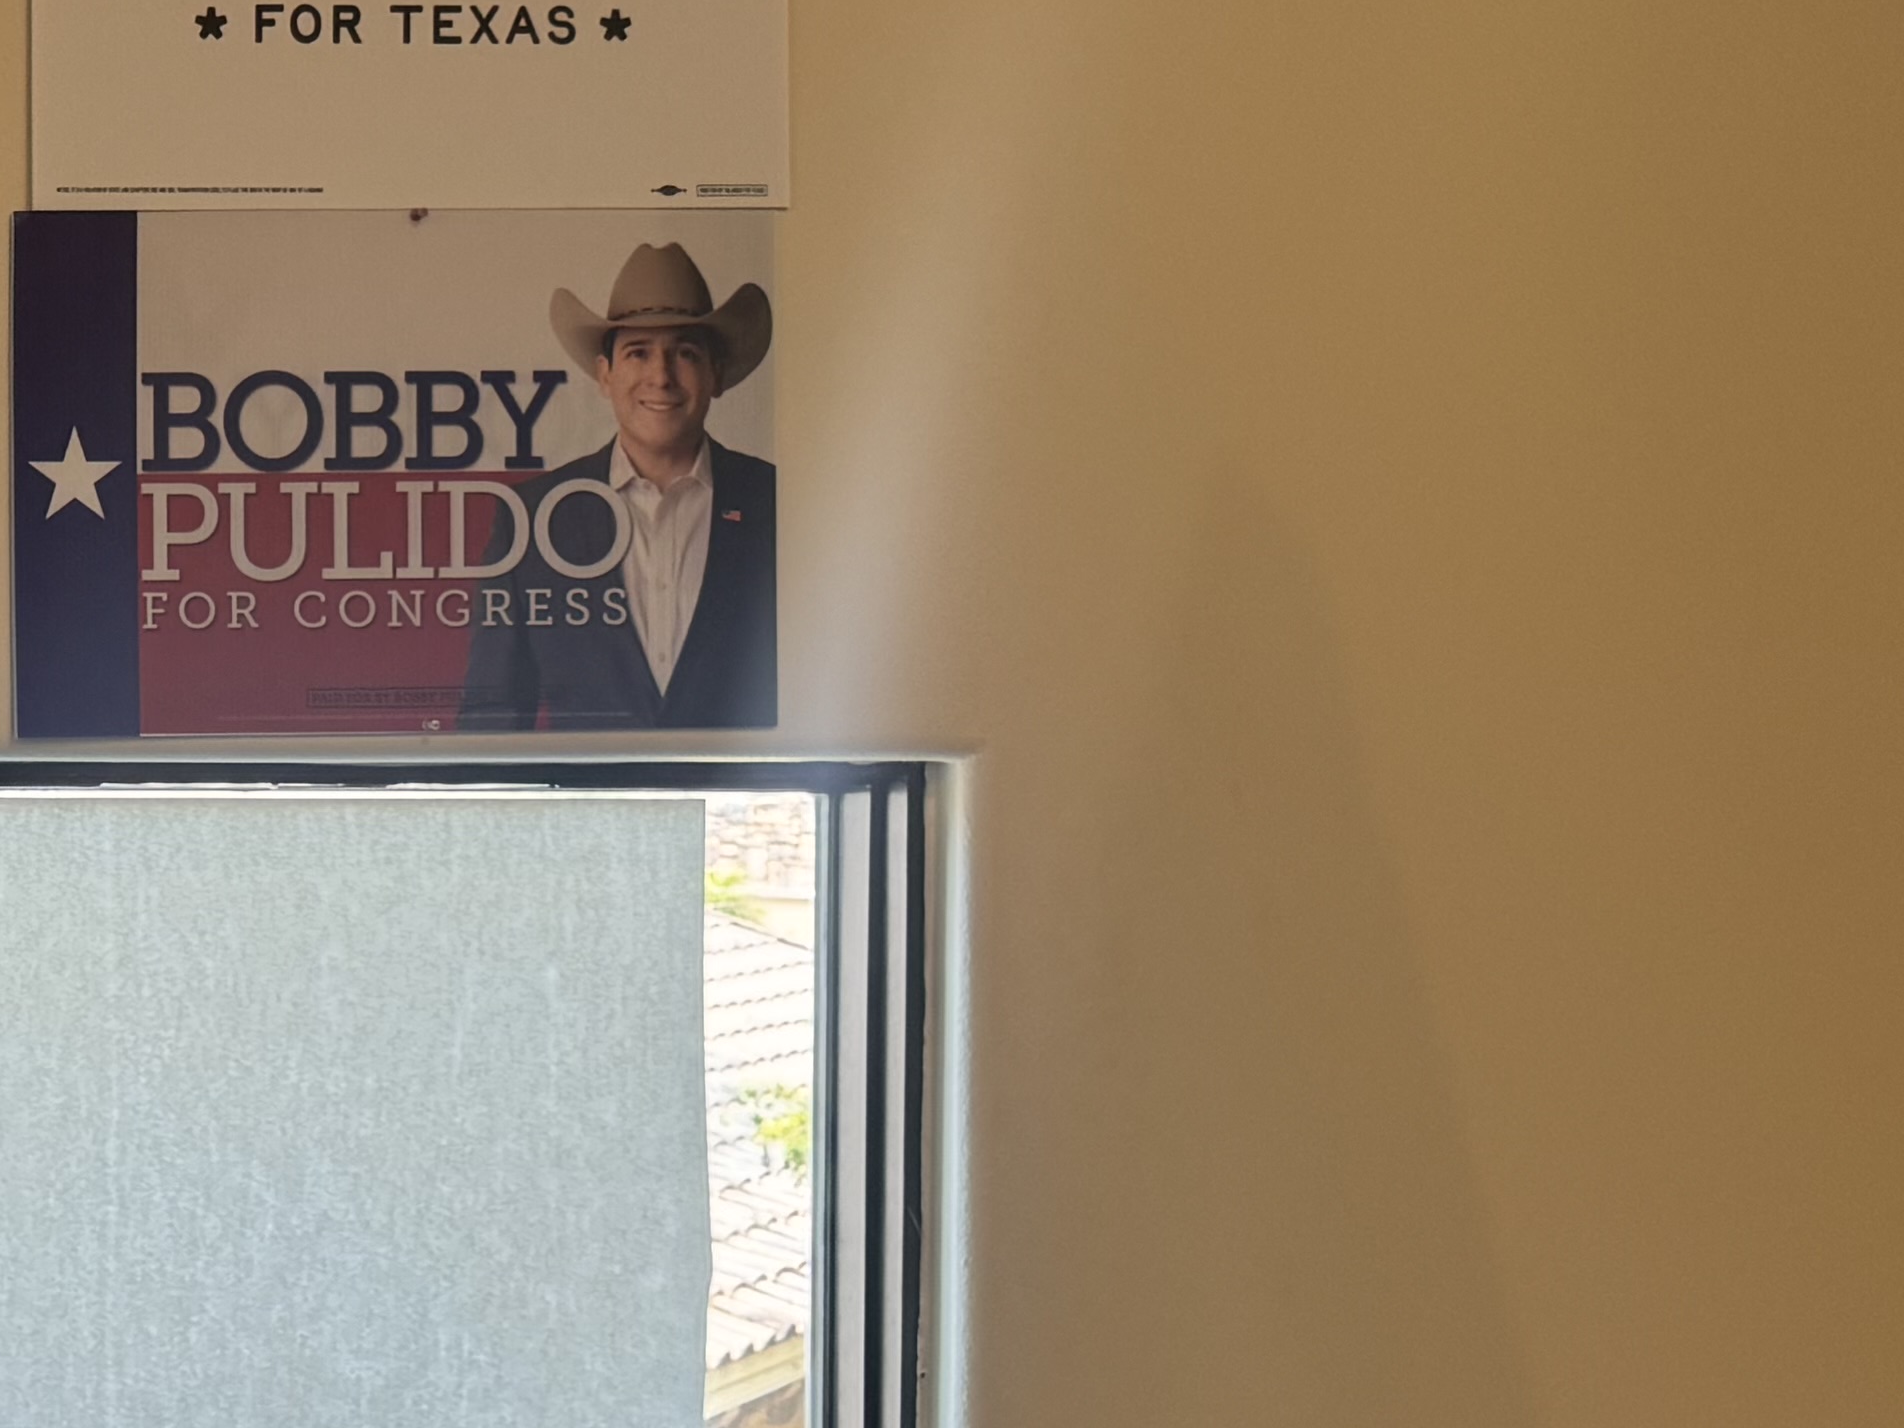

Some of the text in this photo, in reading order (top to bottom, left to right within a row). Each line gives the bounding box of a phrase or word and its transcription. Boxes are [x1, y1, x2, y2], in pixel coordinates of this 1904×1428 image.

[254, 3, 578, 46] FOR TEXAS
[140, 369, 567, 473] BOBBY
[140, 479, 633, 582] PULIDO
[141, 588, 629, 629] FOR CONGRESS
